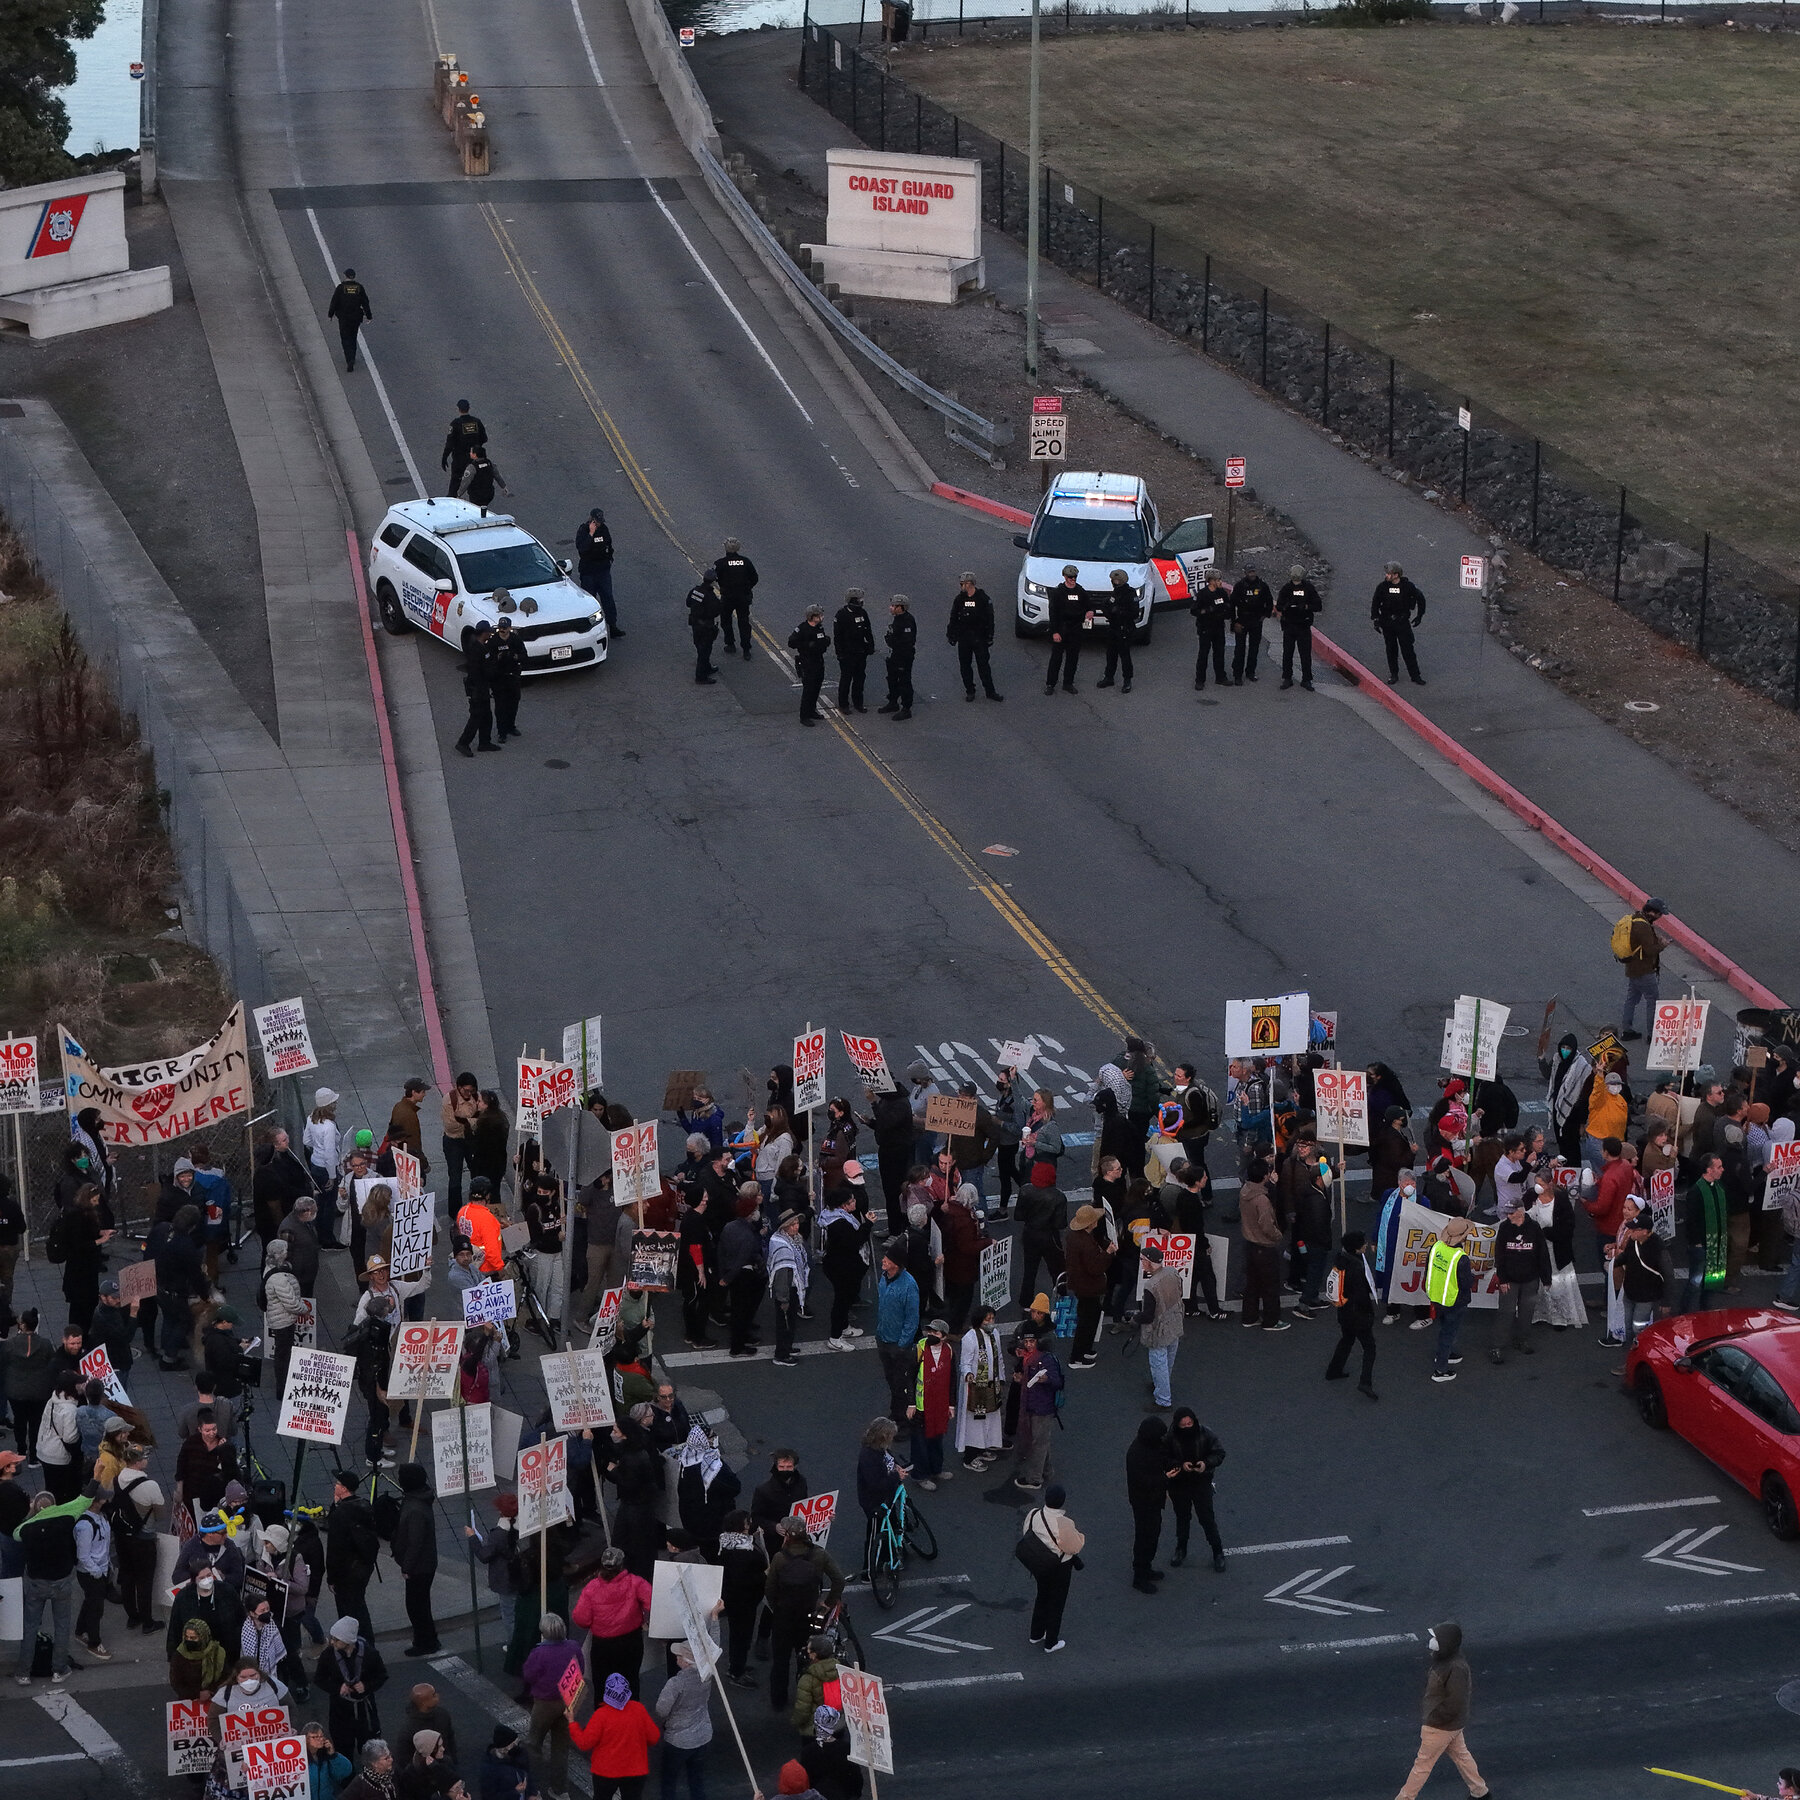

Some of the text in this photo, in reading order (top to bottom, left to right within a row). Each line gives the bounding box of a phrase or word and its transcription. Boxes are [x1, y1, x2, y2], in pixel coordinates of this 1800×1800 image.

[849, 175, 955, 200] COAST GUARD
[872, 196, 929, 216] ISLAND
[1034, 419, 1064, 427] SPEED
[1034, 440, 1063, 456] 20
[1465, 567, 1478, 576] ANY
[1465, 576, 1478, 586] TIME
[402, 588, 435, 614] SECURITY
[262, 1008, 301, 1025] OUR NEIGHBORS
[269, 1004, 290, 1016] PROTECT
[0, 1042, 33, 1060] NO
[271, 1042, 305, 1056] KEEP FAMILIES
[796, 1034, 824, 1058] NO
[843, 1035, 878, 1054] NO
[1588, 1035, 1618, 1058] SANCTUARY
[278, 1049, 301, 1061] TOGETHER
[806, 1048, 825, 1065] TROOPS
[856, 1051, 883, 1062] TROOPS
[6, 1058, 36, 1071] TROOPS
[273, 1063, 295, 1075] FAMILIAS
[0, 1076, 36, 1091] BAY!
[520, 1078, 532, 1090] ICE
[538, 1067, 574, 1096] NO
[796, 1067, 824, 1087] BAY!
[41, 1088, 63, 1100] OTICE
[537, 1079, 577, 1107] ICE TROOPS
[932, 1096, 952, 1108] ICE
[1651, 1171, 1673, 1195] NO
[395, 1196, 429, 1220] FUCK
[1653, 1204, 1674, 1223] BAY!
[394, 1215, 420, 1239] ICE
[393, 1231, 432, 1259] NAZI
[983, 1239, 1009, 1263] NO HATE
[1145, 1235, 1192, 1252] NO
[392, 1251, 429, 1275] SCUM
[982, 1253, 1008, 1277] NO FEAR
[485, 1283, 503, 1297] ICE
[466, 1292, 512, 1315] GO AWAY
[599, 1307, 611, 1319] ICE
[596, 1321, 615, 1338] BA
[81, 1348, 106, 1375] NO
[299, 1358, 348, 1374] OUR NEIGHBORS
[310, 1352, 338, 1365] PROTECT
[291, 1372, 351, 1390] NUESTROS VECINOS
[292, 1400, 336, 1415] KEEP FAMILIES
[298, 1408, 328, 1420] TOGETHER
[287, 1421, 336, 1437] FAMILIAS UNIDAS
[291, 1415, 333, 1428] MANTENIENDO
[793, 1494, 835, 1517] NO
[561, 1662, 577, 1690] END
[568, 1674, 581, 1697] ICE
[169, 1718, 185, 1732] ICE
[225, 1708, 285, 1731] NO
[188, 1730, 196, 1738] IN
[224, 1722, 290, 1743] ICE TROOPS
[247, 1738, 302, 1767] NO
[247, 1757, 307, 1782] ICE TROOPS
[253, 1781, 306, 1800] BAY!
[266, 1778, 275, 1788] IN
